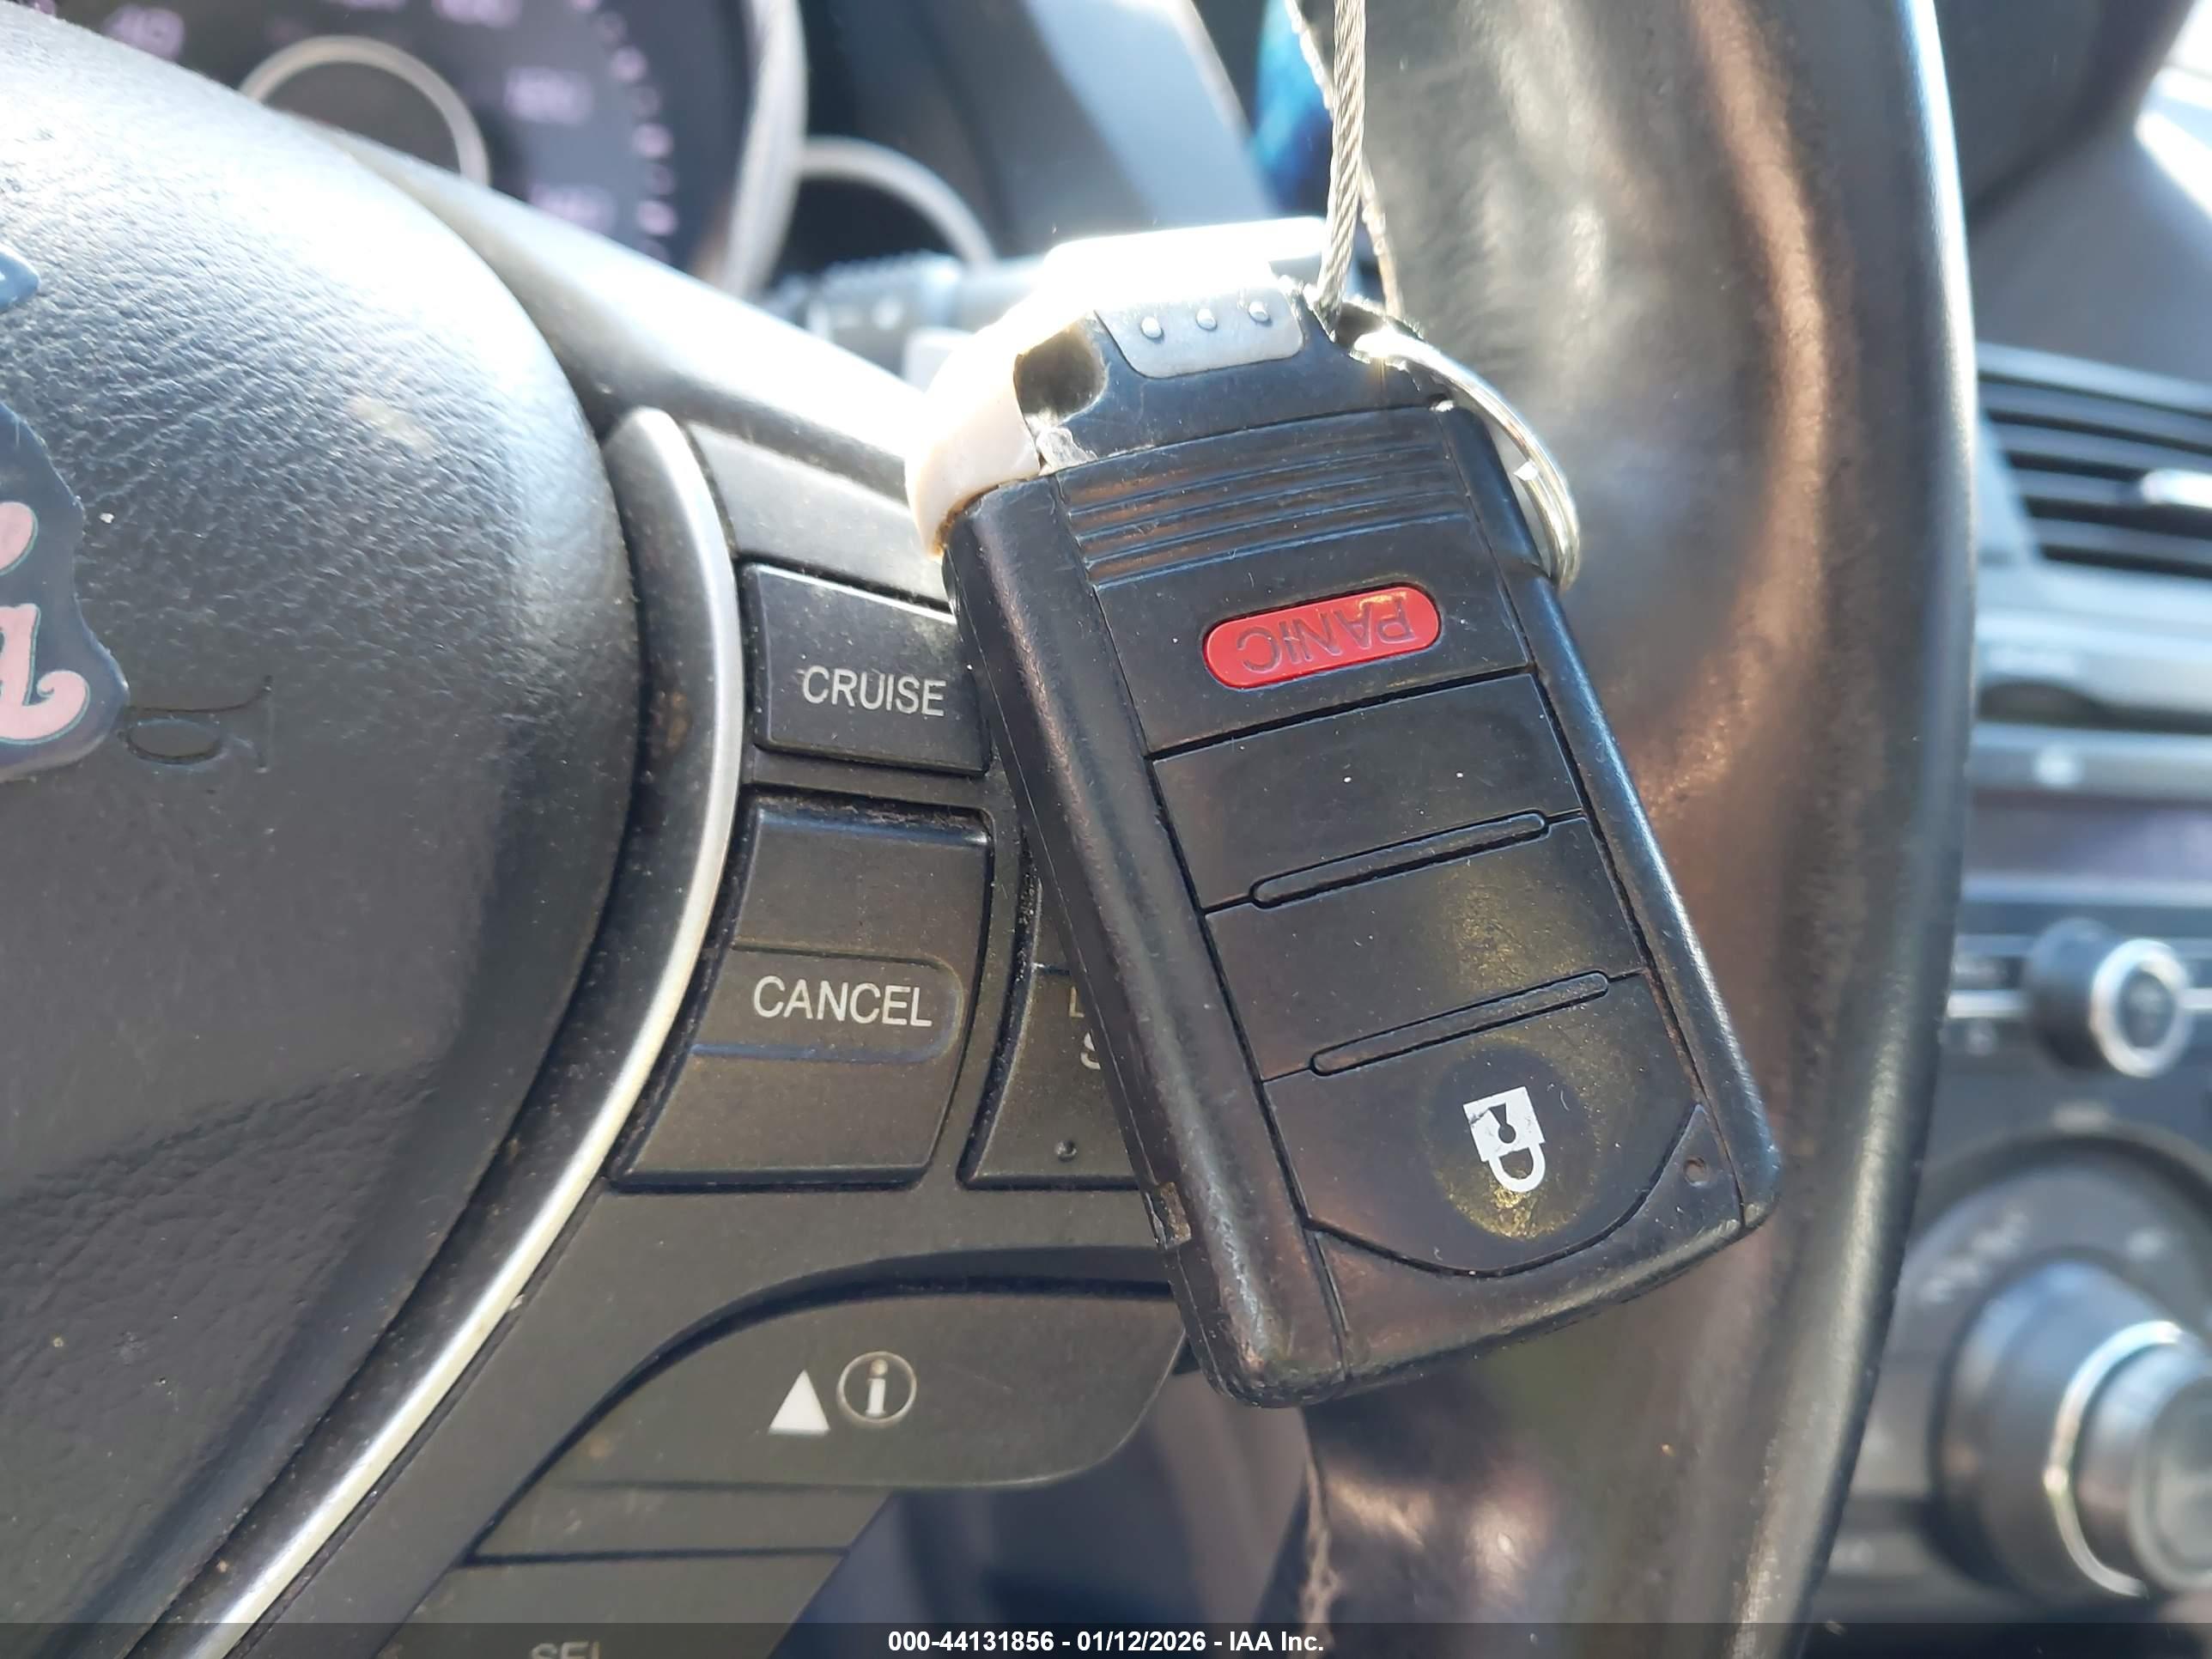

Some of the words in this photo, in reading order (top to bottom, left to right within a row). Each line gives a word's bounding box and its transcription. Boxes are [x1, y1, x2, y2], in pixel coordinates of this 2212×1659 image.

[1235, 592, 1416, 674] PANIC
[802, 665, 947, 717] CRUISE
[753, 975, 933, 1027] CANCEL
